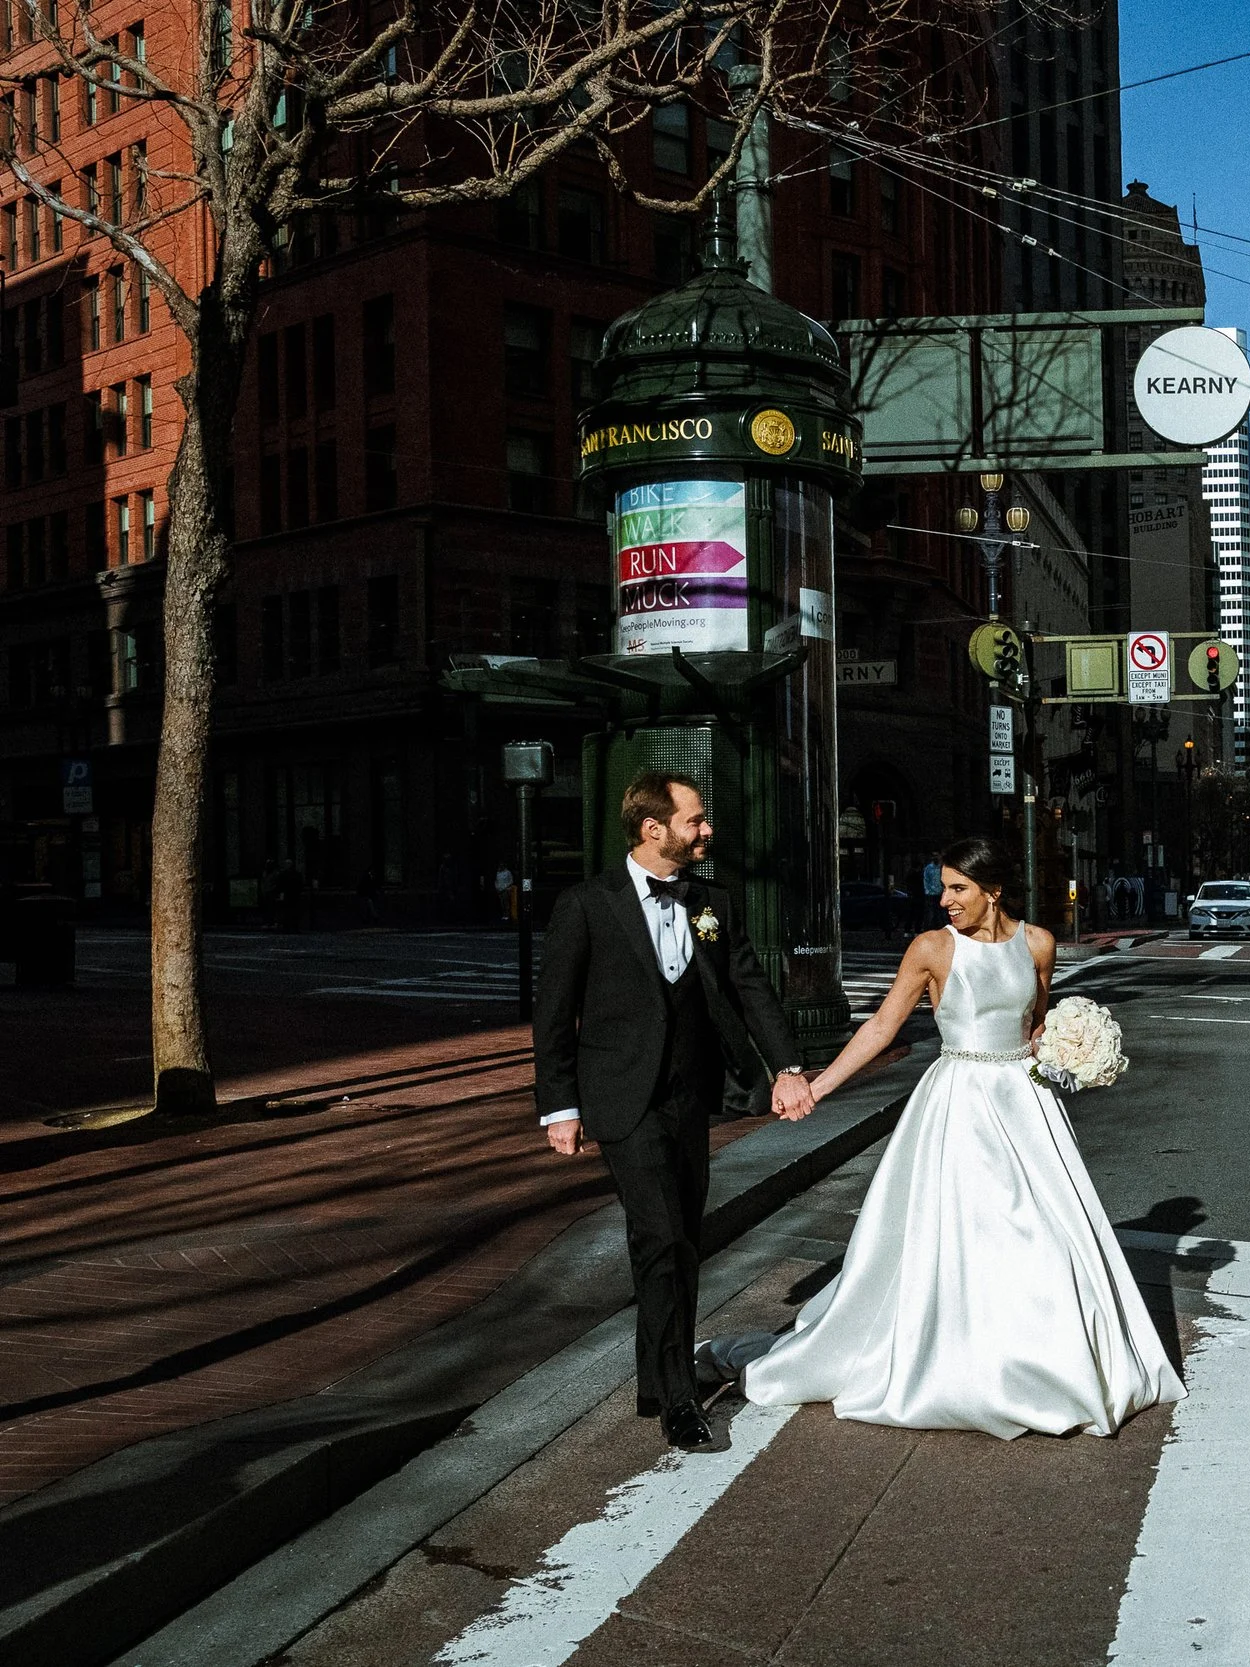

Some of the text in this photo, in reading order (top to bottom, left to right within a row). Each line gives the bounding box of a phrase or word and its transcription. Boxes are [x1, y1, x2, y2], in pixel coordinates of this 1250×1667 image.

[1146, 376, 1238, 395] KEARNY
[599, 418, 713, 450] FRANCISCO
[630, 484, 675, 506] BIKE
[1128, 505, 1185, 525] HOBART
[624, 511, 688, 541] WALK
[1133, 520, 1178, 534] BUILDING
[630, 546, 677, 576] RUN
[624, 581, 691, 612] MUCK
[627, 639, 648, 653] MS
[836, 666, 884, 681] RNY
[996, 709, 1006, 721] NO
[991, 721, 1011, 731] TURNS
[994, 732, 1008, 740] ONTO
[991, 740, 1011, 749] MARKET
[993, 759, 1010, 767] EXCEPT
[793, 944, 829, 957] sleepwear
